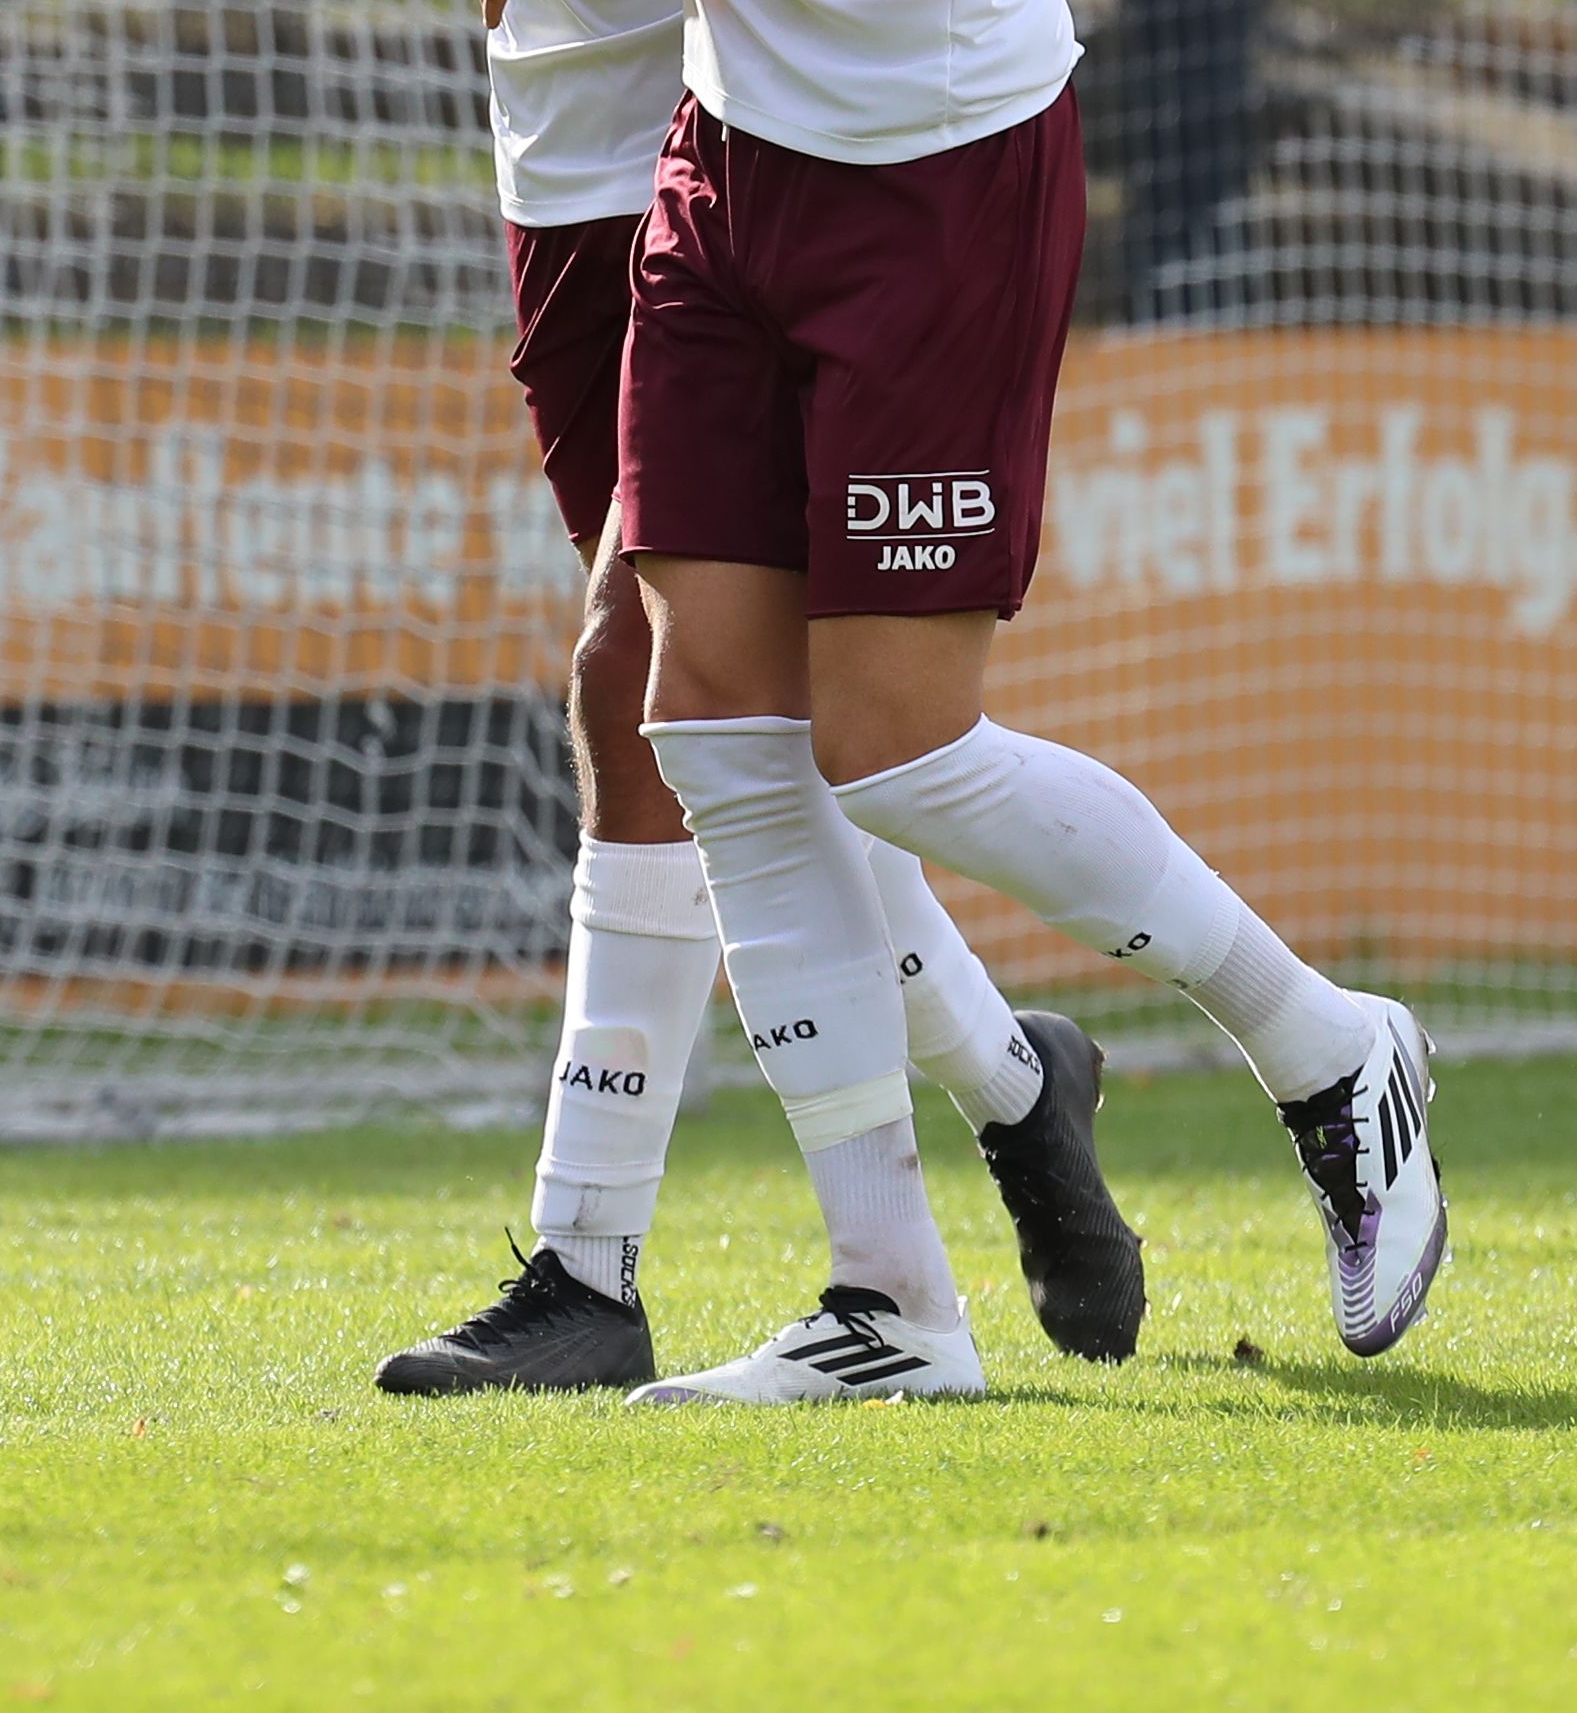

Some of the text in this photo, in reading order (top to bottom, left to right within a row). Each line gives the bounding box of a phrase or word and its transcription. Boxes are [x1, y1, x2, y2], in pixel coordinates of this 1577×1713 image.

[1054, 408, 1237, 589] viel
[877, 544, 956, 571] JAKO
[558, 1060, 648, 1097] JAKO
